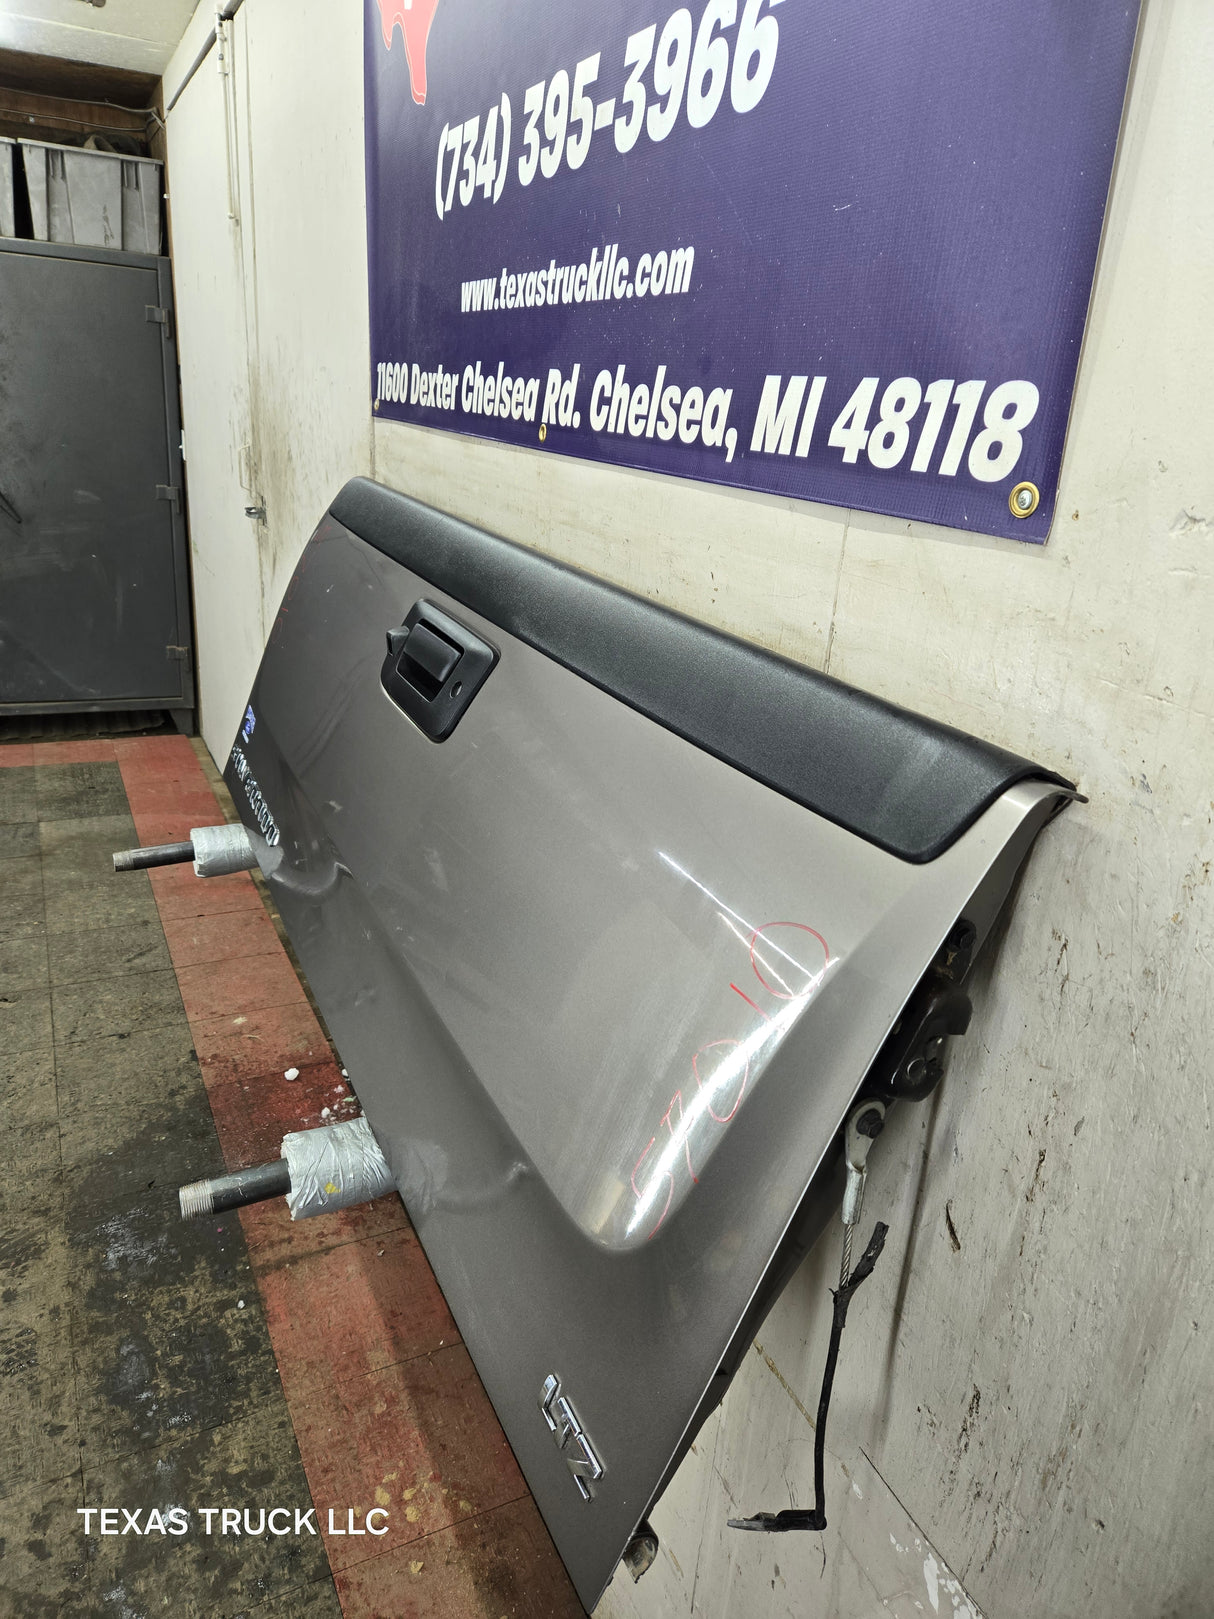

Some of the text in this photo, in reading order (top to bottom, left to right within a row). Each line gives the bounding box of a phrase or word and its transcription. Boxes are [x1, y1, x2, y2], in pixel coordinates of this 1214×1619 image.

[435, 0, 787, 221] (734) 395-3966
[461, 243, 694, 313] www.texastruckllc.com
[377, 361, 1040, 483] 11600 Dexter Chelsea Rd. Chelsea, MI 48118
[537, 1374, 603, 1501] LTZ
